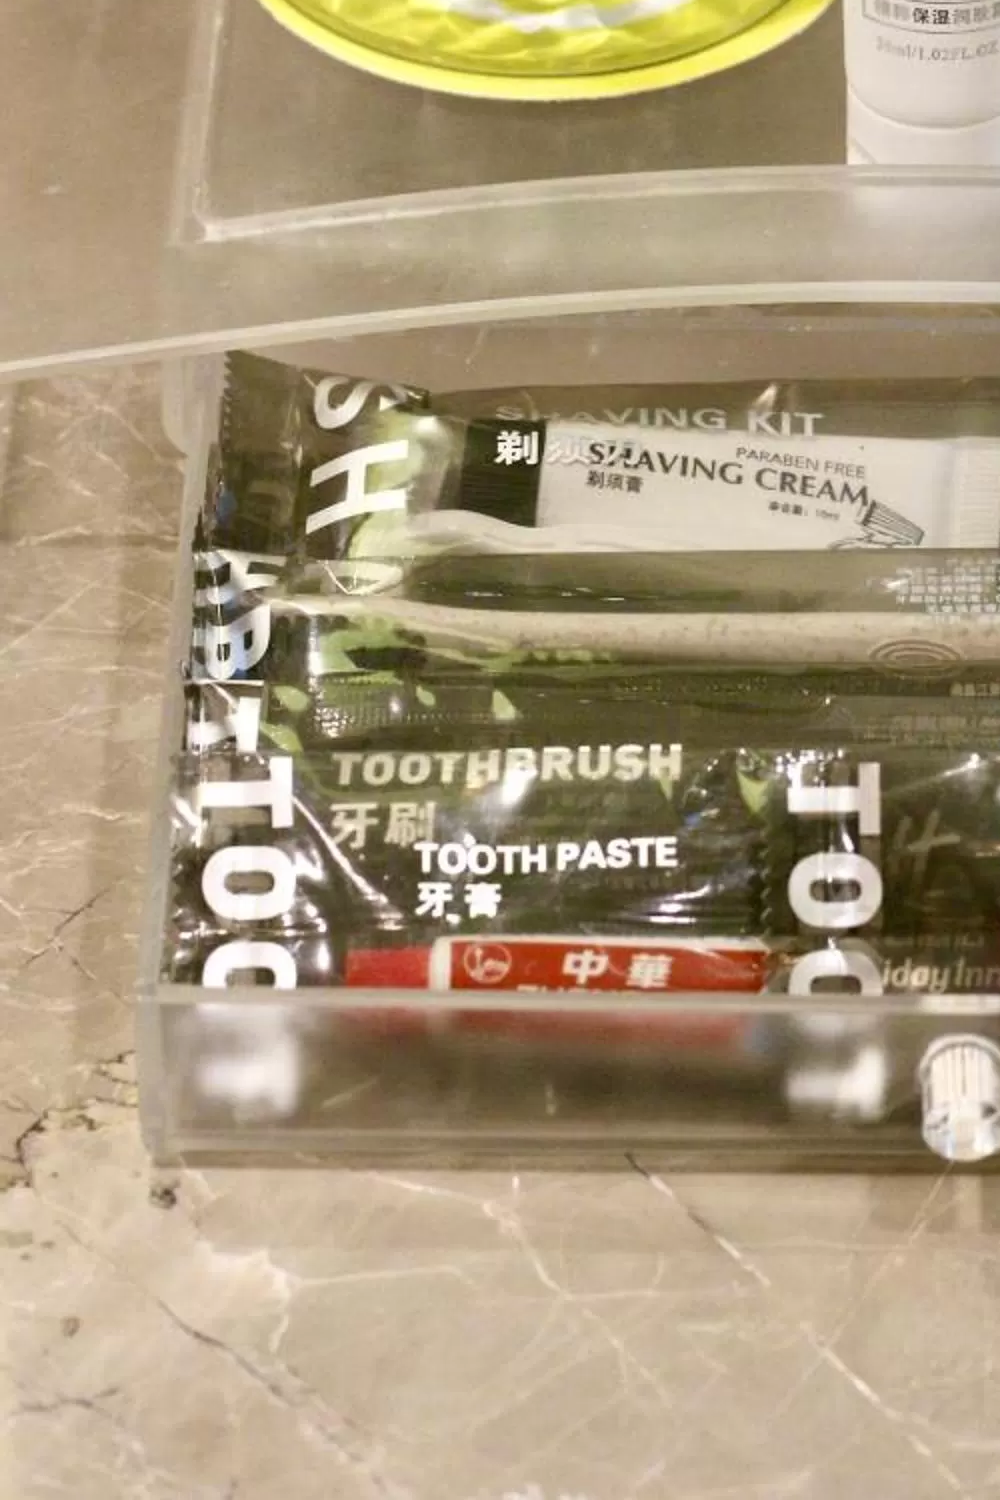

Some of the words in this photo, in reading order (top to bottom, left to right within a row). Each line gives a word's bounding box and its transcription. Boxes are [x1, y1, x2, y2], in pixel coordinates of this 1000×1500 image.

[746, 408, 825, 436] KIT
[735, 446, 819, 471] PARABEN
[824, 459, 866, 479] FREE
[754, 466, 869, 507] CREAM
[332, 743, 683, 787] TOOTHBRUSH
[330, 801, 437, 849] 牙刷
[414, 840, 547, 875] TOOTH
[556, 836, 679, 871] PASTE
[413, 882, 503, 920] 牙膏
[562, 948, 674, 989] 中華
